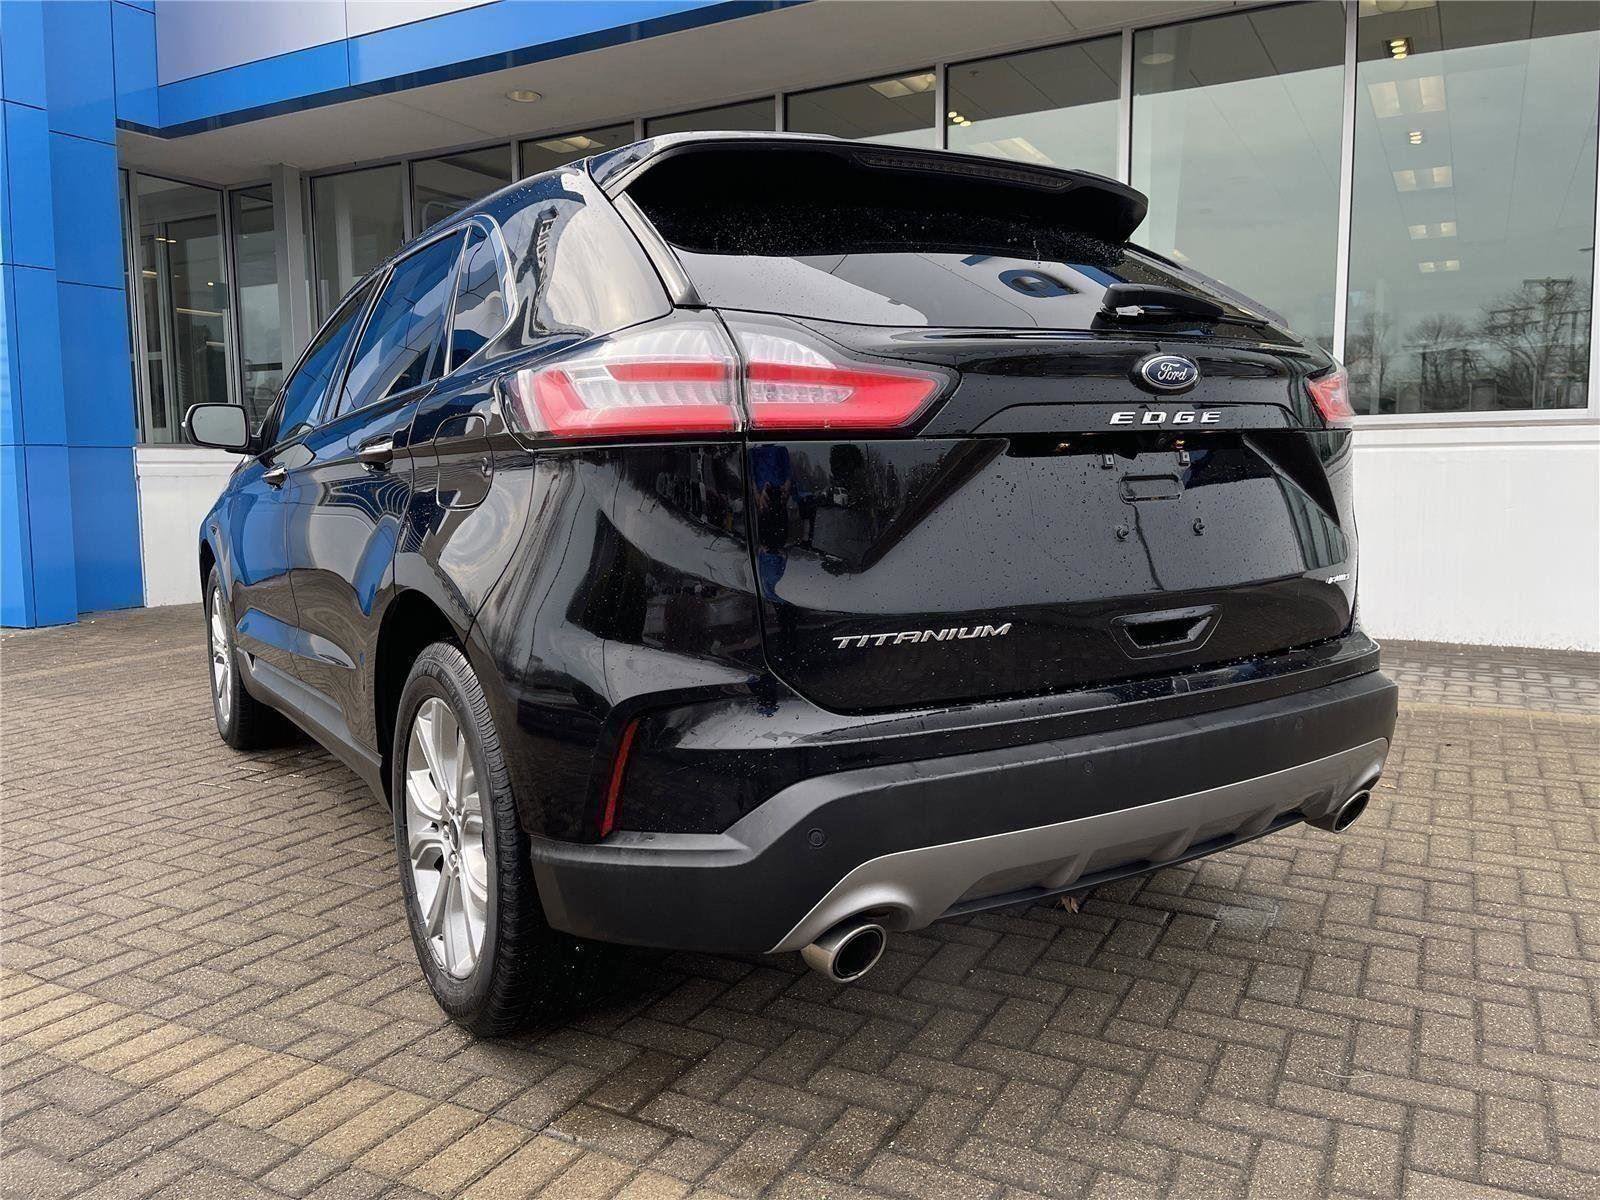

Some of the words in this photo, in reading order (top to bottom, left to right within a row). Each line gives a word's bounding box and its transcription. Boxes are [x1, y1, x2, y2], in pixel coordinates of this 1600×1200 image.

[1157, 362, 1188, 381] Ford
[1109, 411, 1222, 425] EDGE
[832, 622, 1012, 649] TITANIUM
